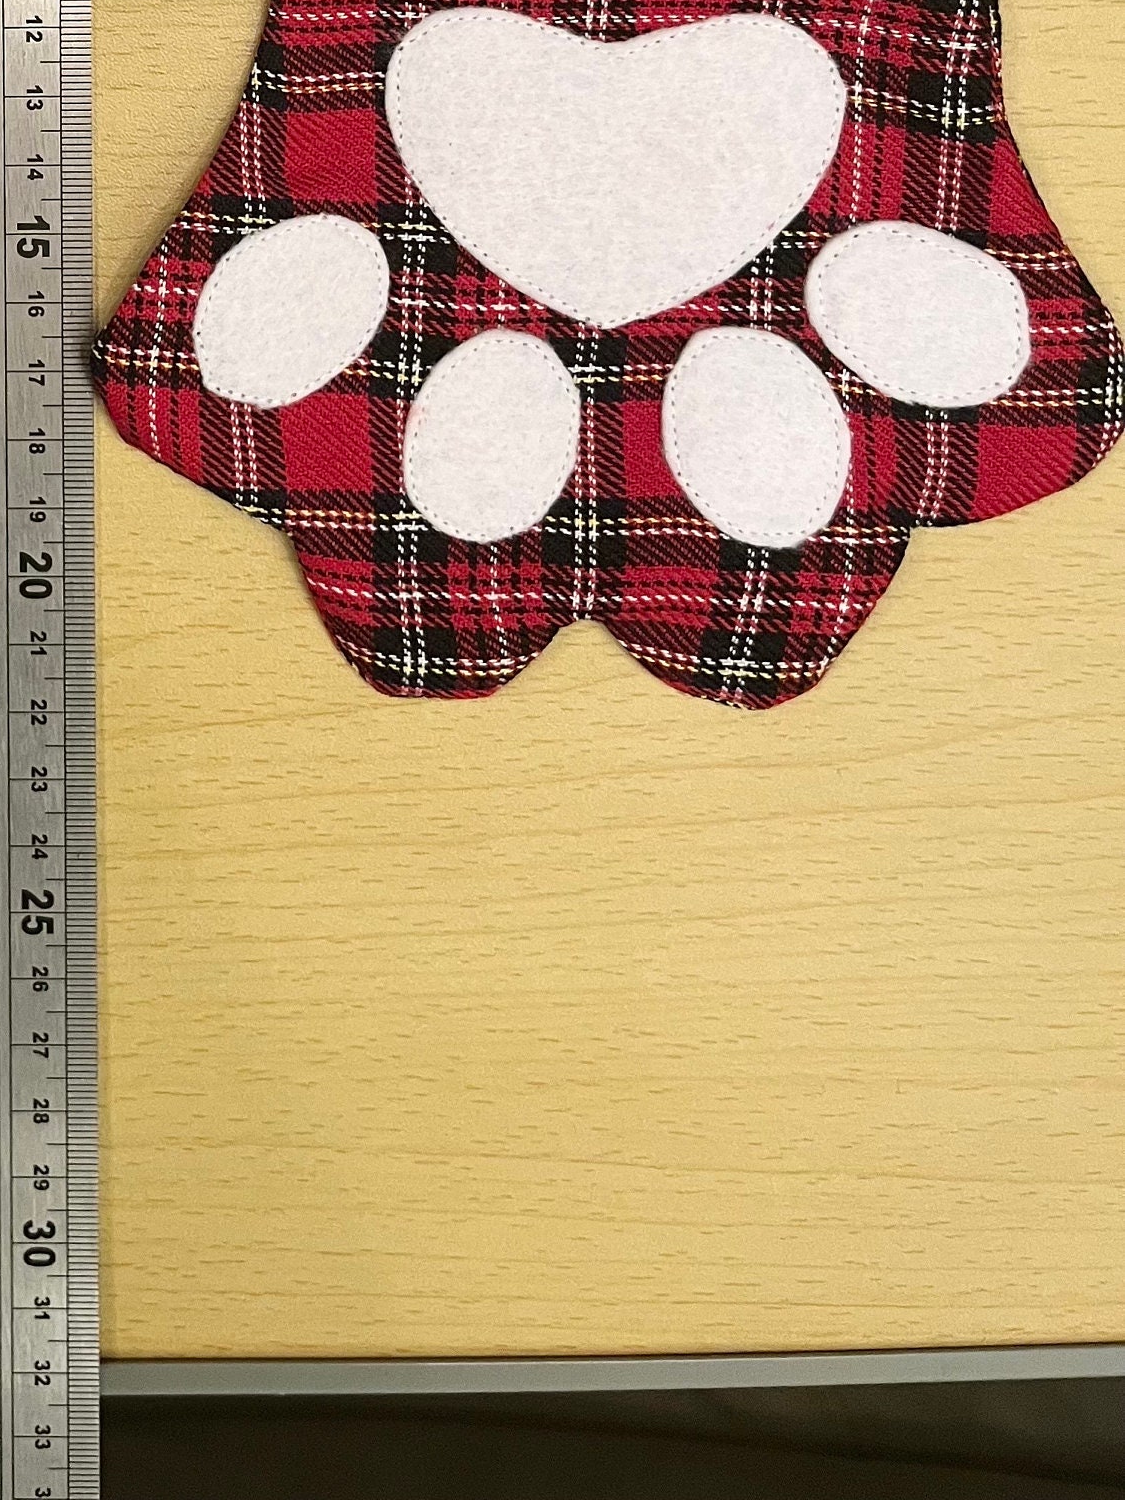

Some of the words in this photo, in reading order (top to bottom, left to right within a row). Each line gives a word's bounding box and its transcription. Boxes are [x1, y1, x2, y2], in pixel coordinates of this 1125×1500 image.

[25, 14, 44, 43] 12
[25, 84, 44, 111] 13
[26, 153, 44, 181] 14
[16, 214, 51, 259] 15
[27, 290, 45, 318] 16
[27, 359, 46, 387] 17
[28, 427, 46, 455] 18
[28, 496, 47, 523] 19
[19, 551, 53, 600] 20
[29, 630, 48, 656] 21
[30, 698, 48, 726] 22
[30, 766, 49, 793] 23
[31, 833, 49, 860] 24
[21, 888, 55, 936] 25
[31, 965, 49, 993] 26
[32, 1031, 50, 1060] 27
[32, 1097, 50, 1125] 28
[32, 1164, 50, 1191] 29
[22, 1219, 57, 1268] 30
[33, 1296, 51, 1320] 31
[33, 1359, 51, 1387] 32
[34, 1424, 52, 1450] 33
[34, 1487, 52, 1499] 3
